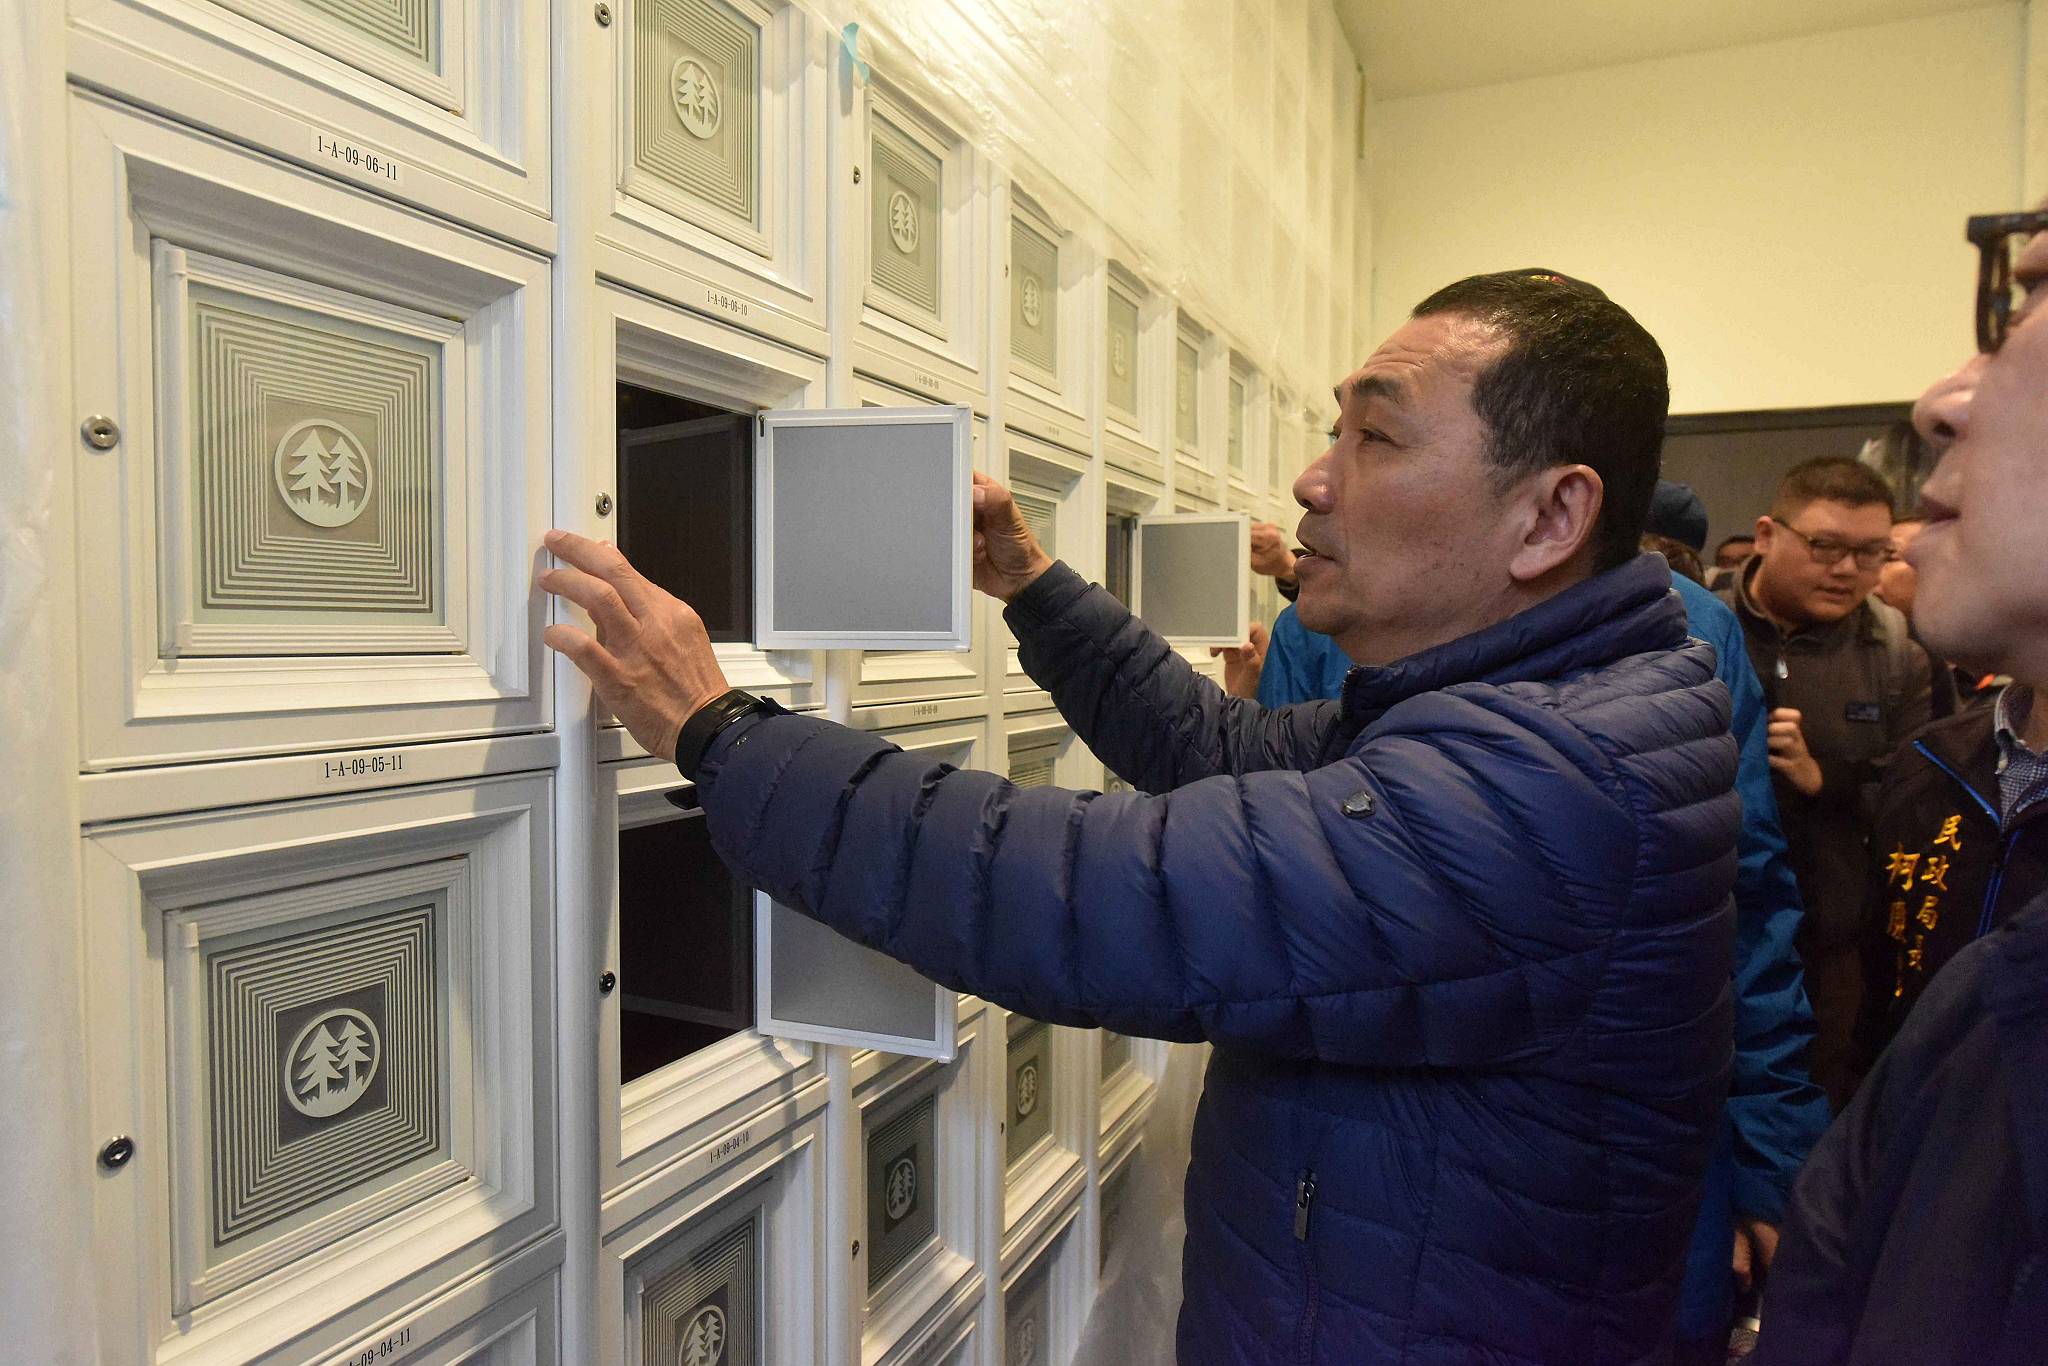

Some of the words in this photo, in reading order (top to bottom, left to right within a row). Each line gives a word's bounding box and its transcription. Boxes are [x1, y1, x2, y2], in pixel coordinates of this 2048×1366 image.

[318, 135, 397, 181] 1-A-09-06-11
[324, 754, 402, 778] 1-A-09-05-11
[349, 1327, 411, 1366] -09-04-11
